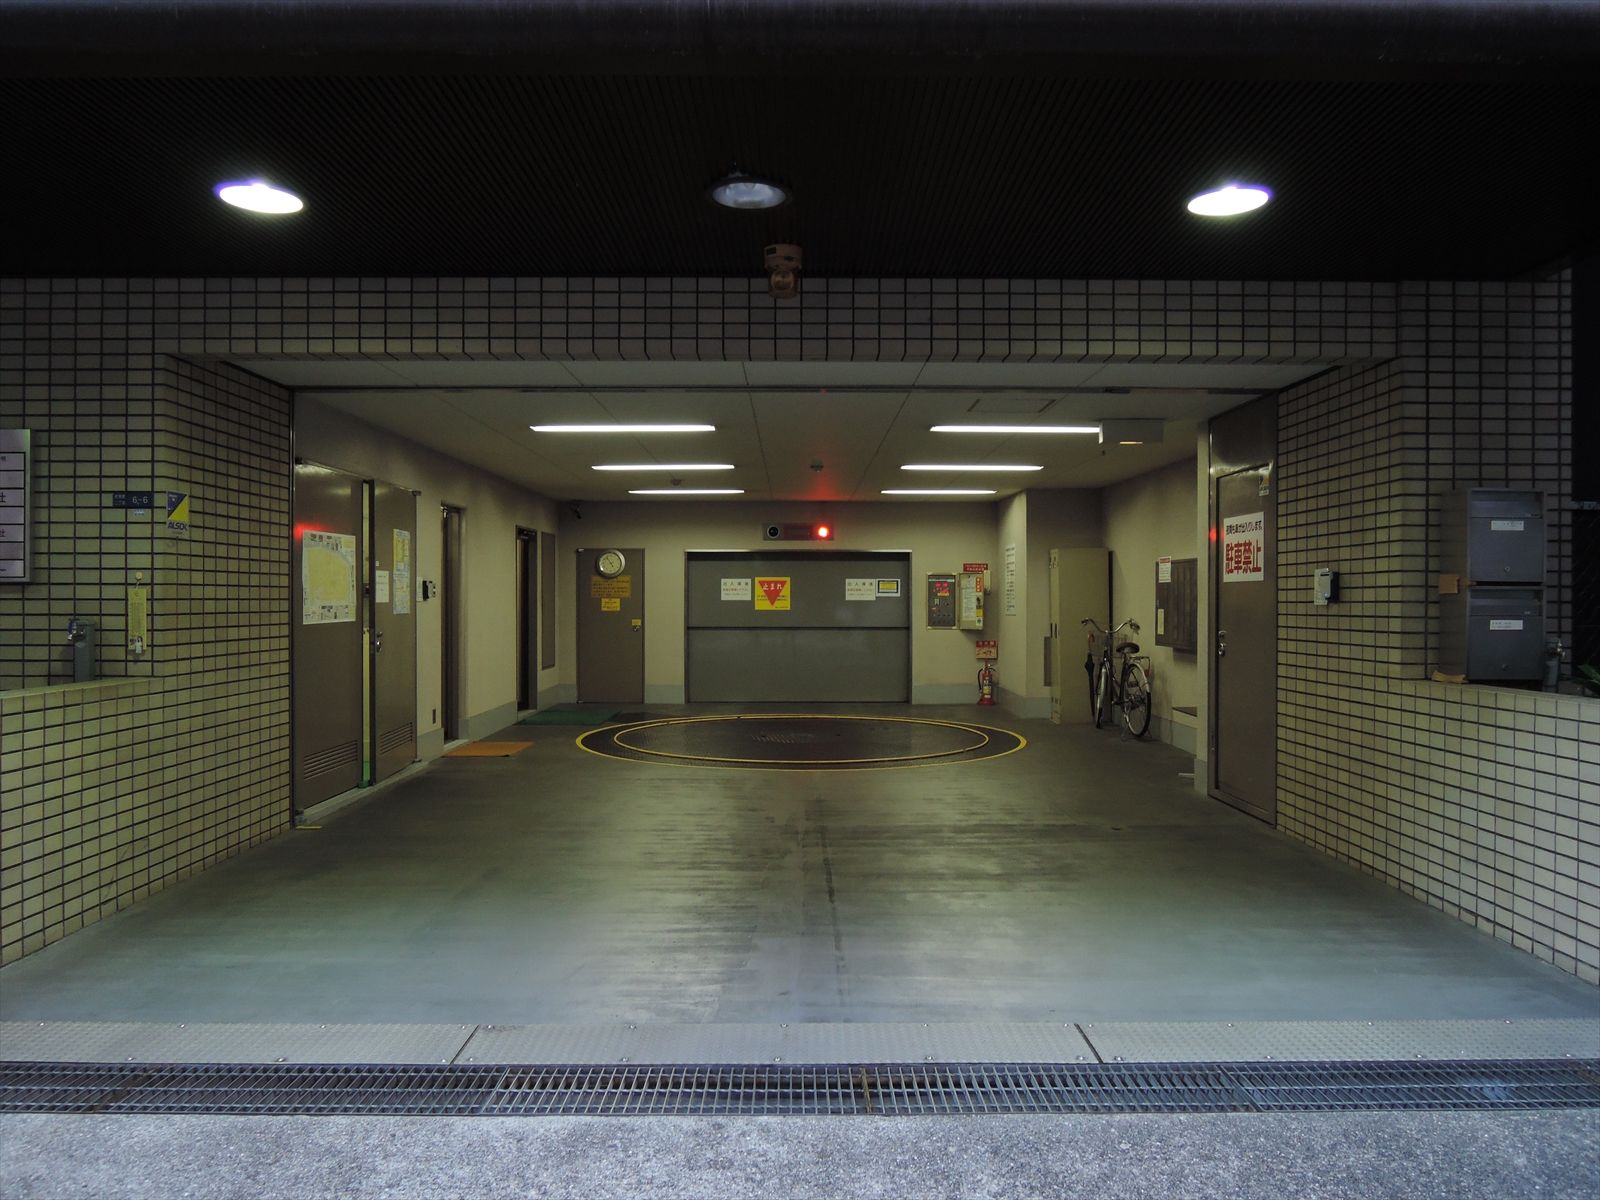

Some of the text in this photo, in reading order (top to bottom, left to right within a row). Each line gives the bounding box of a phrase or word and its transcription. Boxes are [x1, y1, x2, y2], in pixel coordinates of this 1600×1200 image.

[1225, 539, 1262, 575] 駐車禁止
[763, 583, 782, 591] 止まれ
